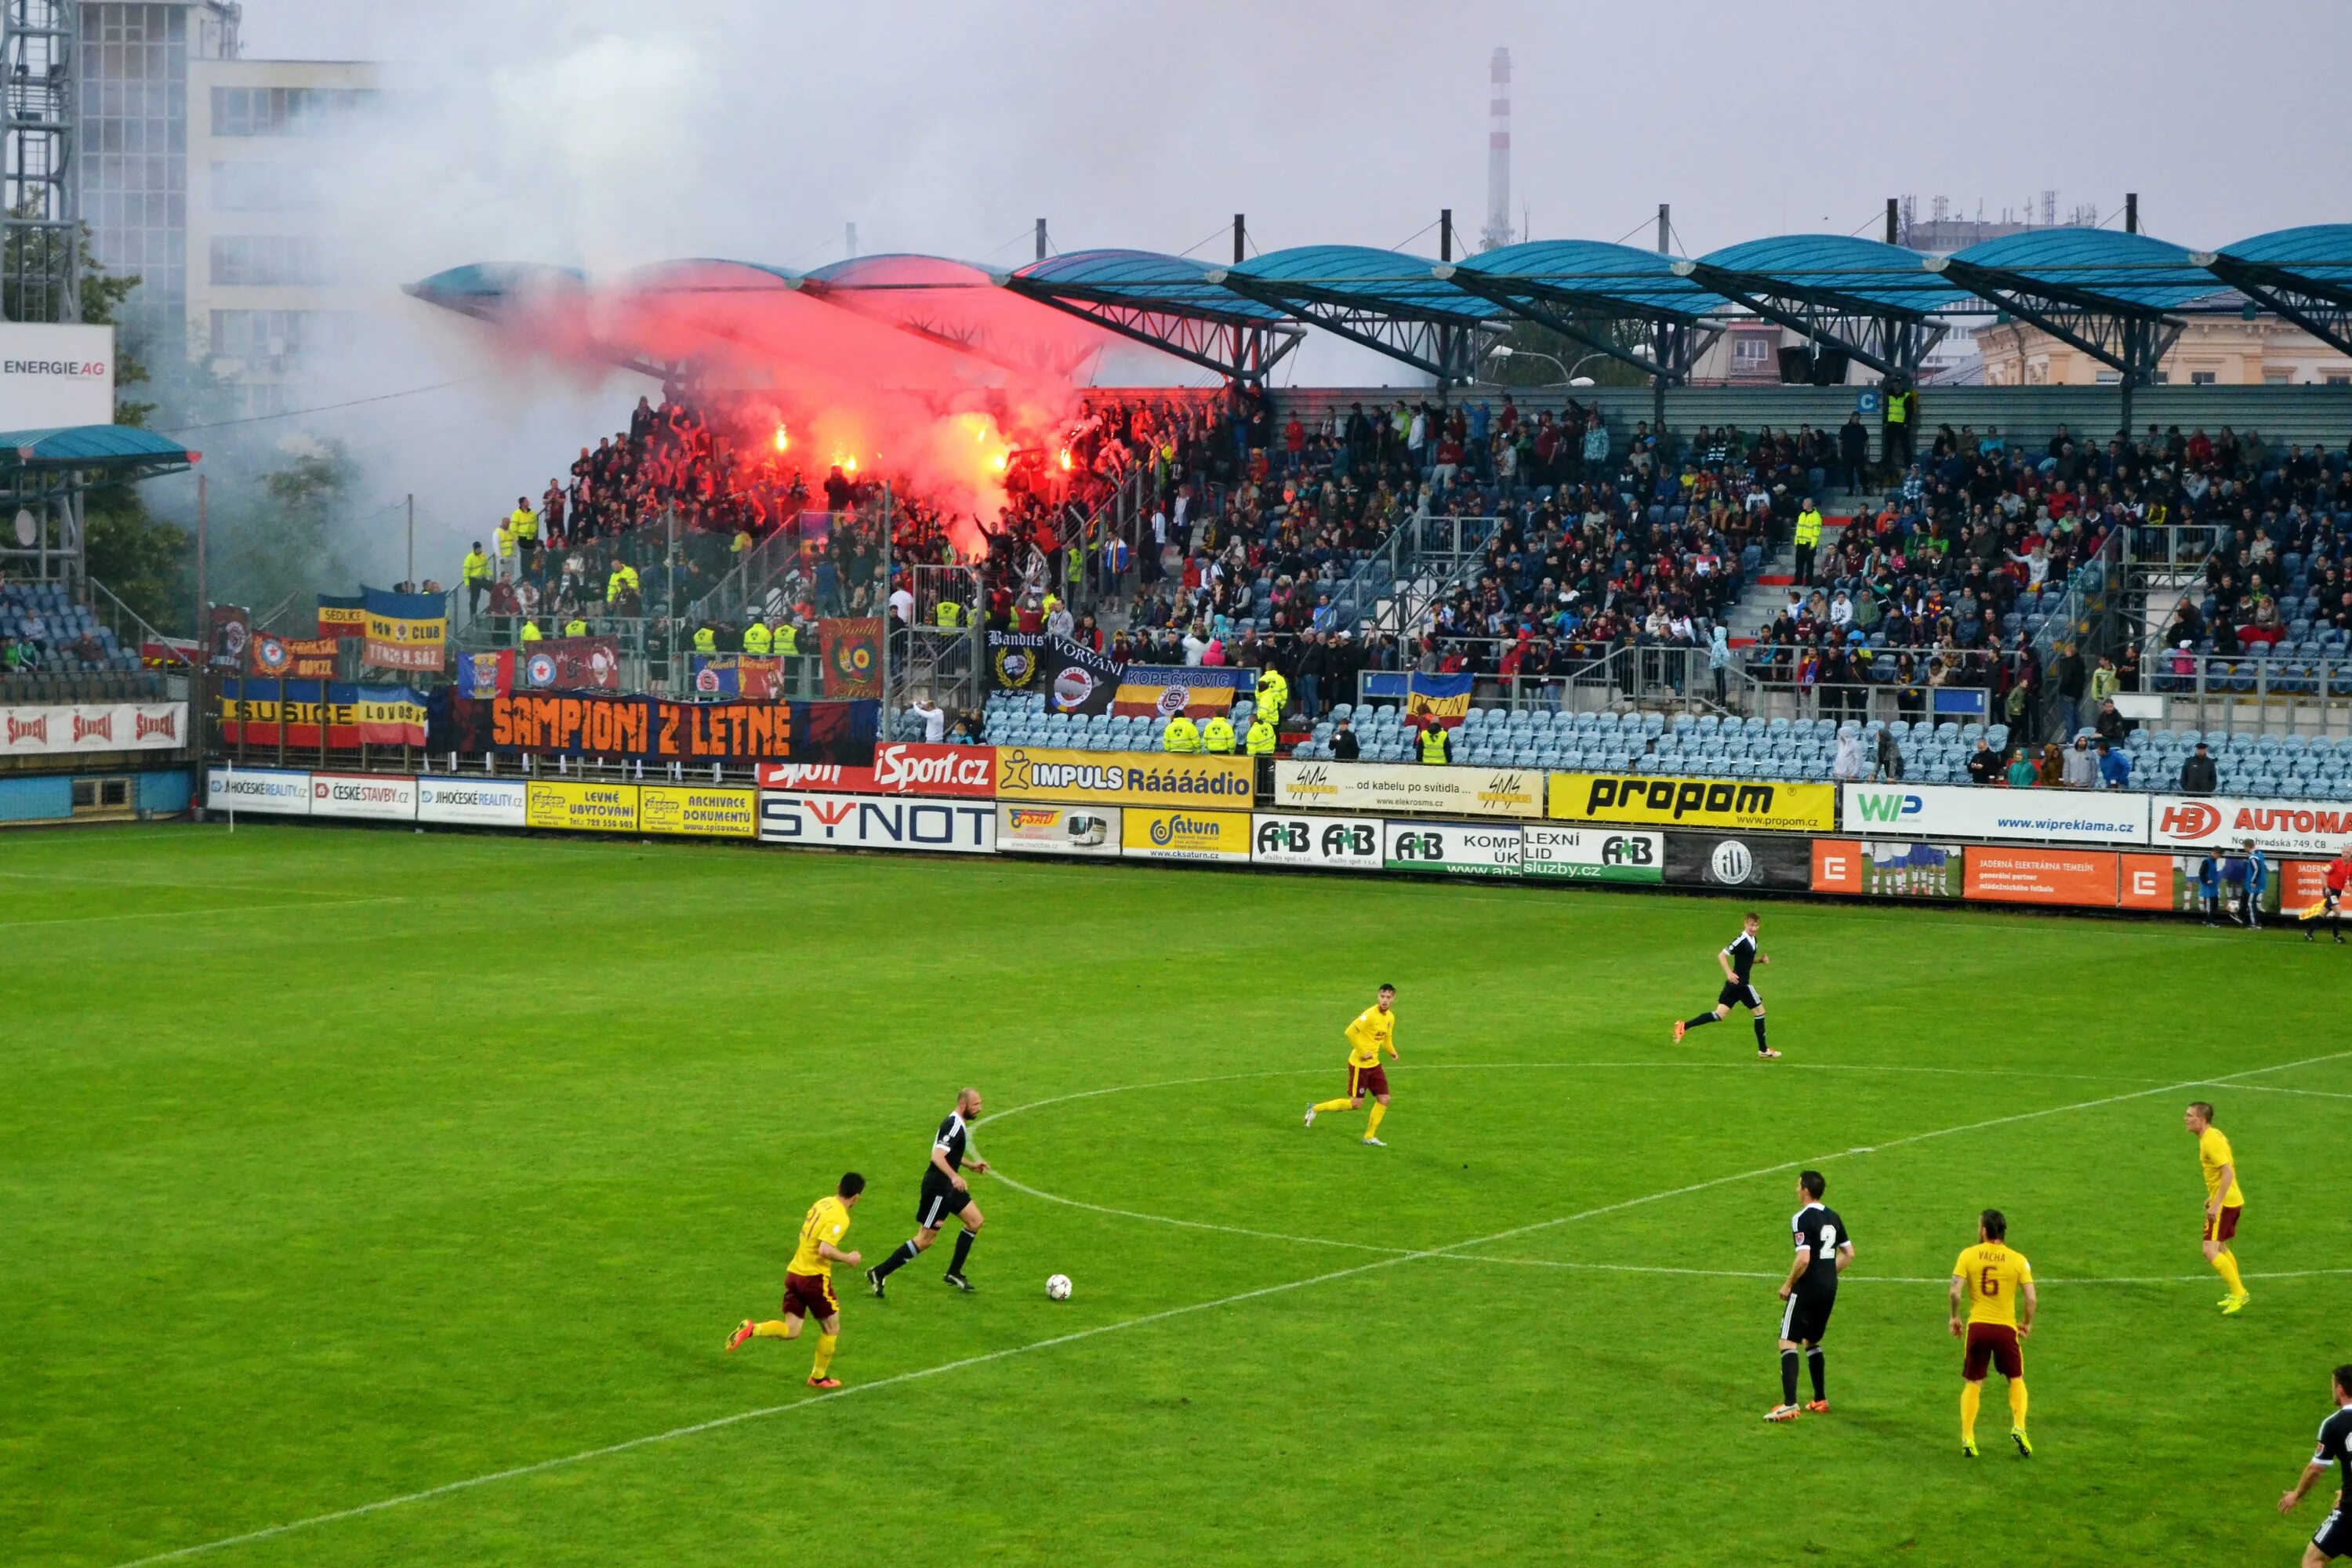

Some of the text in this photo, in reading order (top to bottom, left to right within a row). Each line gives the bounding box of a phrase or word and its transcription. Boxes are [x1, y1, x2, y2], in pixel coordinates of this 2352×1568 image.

[4, 361, 105, 376] ENERGIE AG
[1860, 394, 1874, 409] C
[412, 626, 440, 640] CLUB
[988, 630, 1045, 647] Bandits
[1053, 637, 1124, 677] VORVANI
[1127, 669, 1230, 688] KOPEČKOVIC
[691, 699, 791, 756] LETNÉ
[873, 744, 989, 790] iSport.cz
[1031, 762, 1250, 795] IMPULS Ráááádio
[224, 779, 307, 798] JHOČESKÉREALITY.cz
[1356, 781, 1369, 789] od
[1372, 781, 1405, 791] kabelu
[1408, 784, 1421, 793] po
[1424, 782, 1460, 793] svítidla
[585, 790, 619, 804] LEVNÉ
[688, 796, 746, 808] ARCHIVACE
[1586, 779, 1775, 820] propom
[569, 804, 634, 818] UBYTOVÁNÍ
[1857, 793, 1923, 822] WIP
[684, 809, 750, 822] DOKUMENTŮ
[761, 798, 995, 845] SYNOT
[1737, 815, 1818, 826] www.propom.cz
[1150, 814, 1220, 846] Saturn
[1998, 818, 2134, 833] www.wipreklama.cz
[1525, 832, 1580, 846] LEXNÍ
[2232, 837, 2290, 848] Nohradská
[2294, 839, 2312, 849] 749,
[2314, 838, 2326, 849] ČB
[1150, 850, 1220, 859] www.cksaturn.cz
[1525, 848, 1552, 859] LID
[1523, 861, 1602, 877] sluzby.cz
[1980, 859, 2094, 872] JADERNÁ ELEKTRÁRNA TEMELÍN
[1979, 872, 2012, 881] generální
[2031, 884, 2054, 893] fotbalu
[1819, 1225, 1837, 1260] 2
[1980, 1265, 1999, 1298] 6
